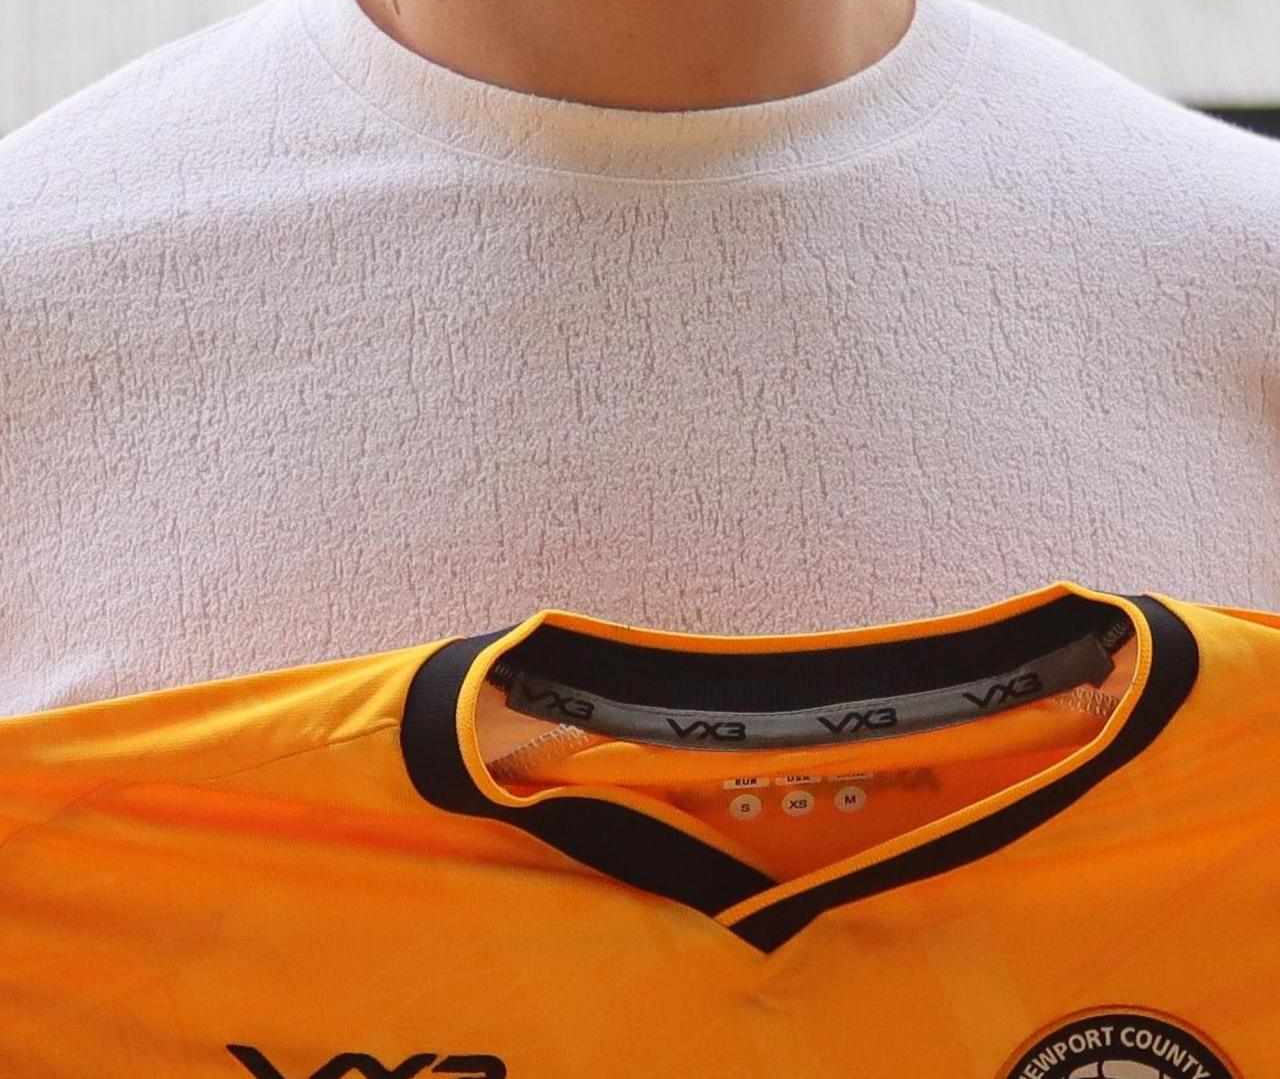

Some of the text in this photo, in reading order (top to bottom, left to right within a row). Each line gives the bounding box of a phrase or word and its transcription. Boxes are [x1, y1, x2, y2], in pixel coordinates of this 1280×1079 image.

[521, 681, 596, 721] VX3
[962, 672, 1044, 709] VX3
[666, 717, 747, 742] VX3
[816, 707, 899, 734] VX3
[740, 794, 857, 813] S XS M
[1017, 1026, 1211, 1079] EWPORT COUNTY
